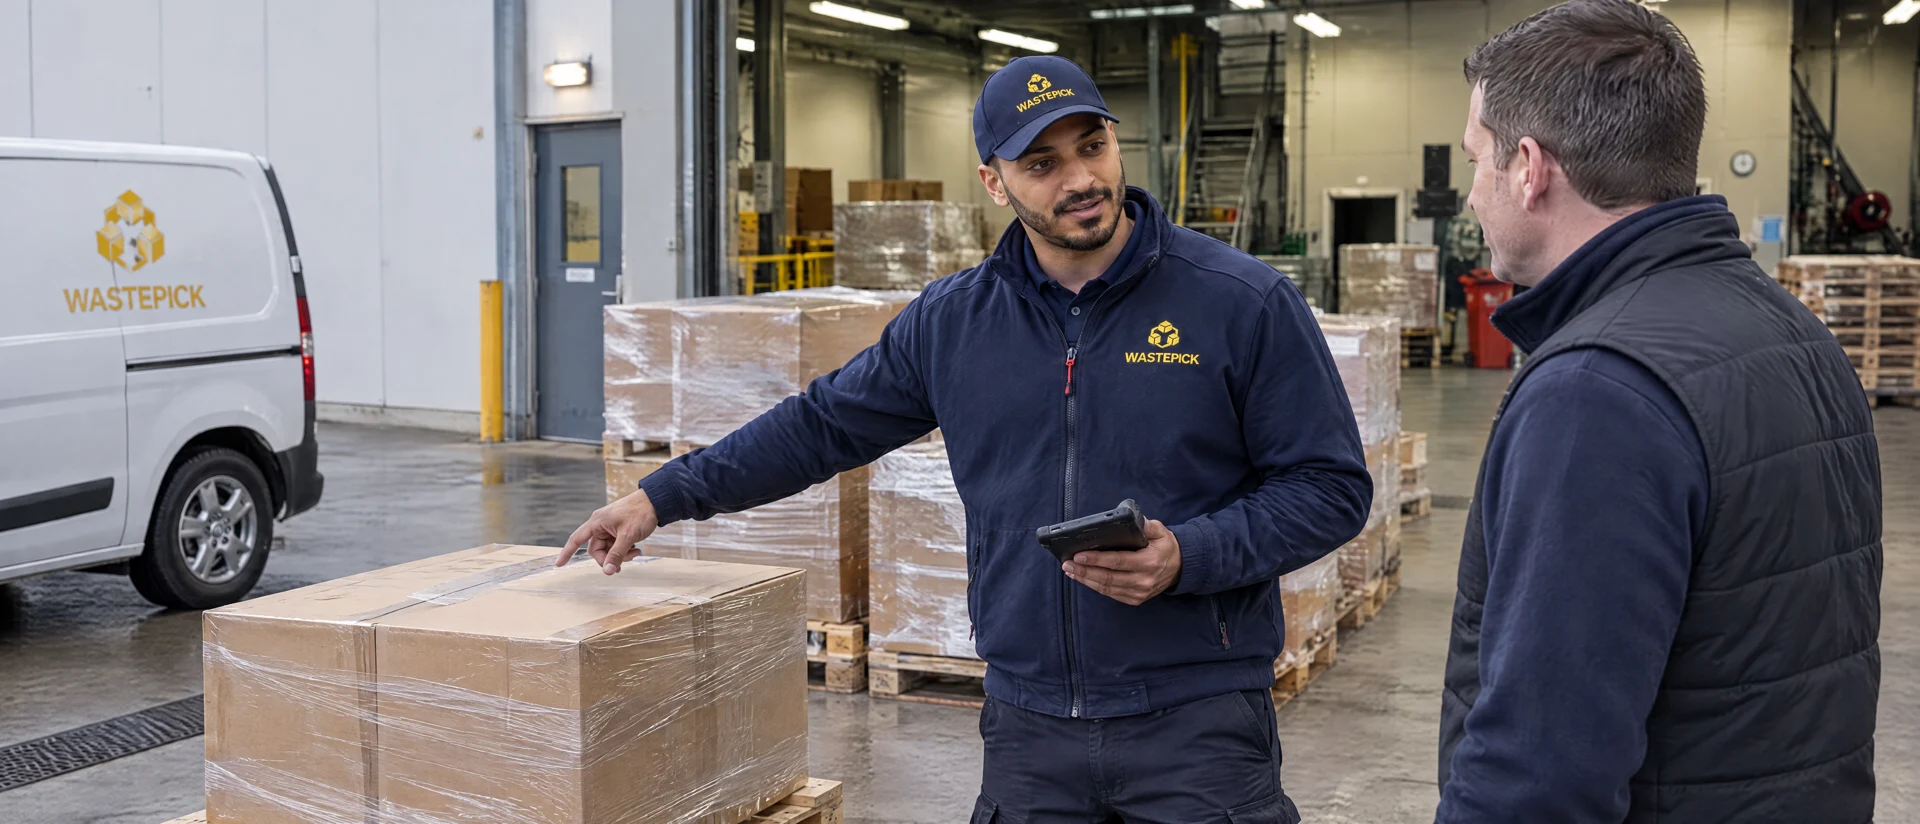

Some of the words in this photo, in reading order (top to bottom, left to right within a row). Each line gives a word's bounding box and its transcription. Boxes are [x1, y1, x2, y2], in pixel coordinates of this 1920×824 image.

[1016, 88, 1075, 113] WASTEPICK
[63, 284, 206, 313] WASTEPICK
[1125, 352, 1200, 365] WASTEPICK
